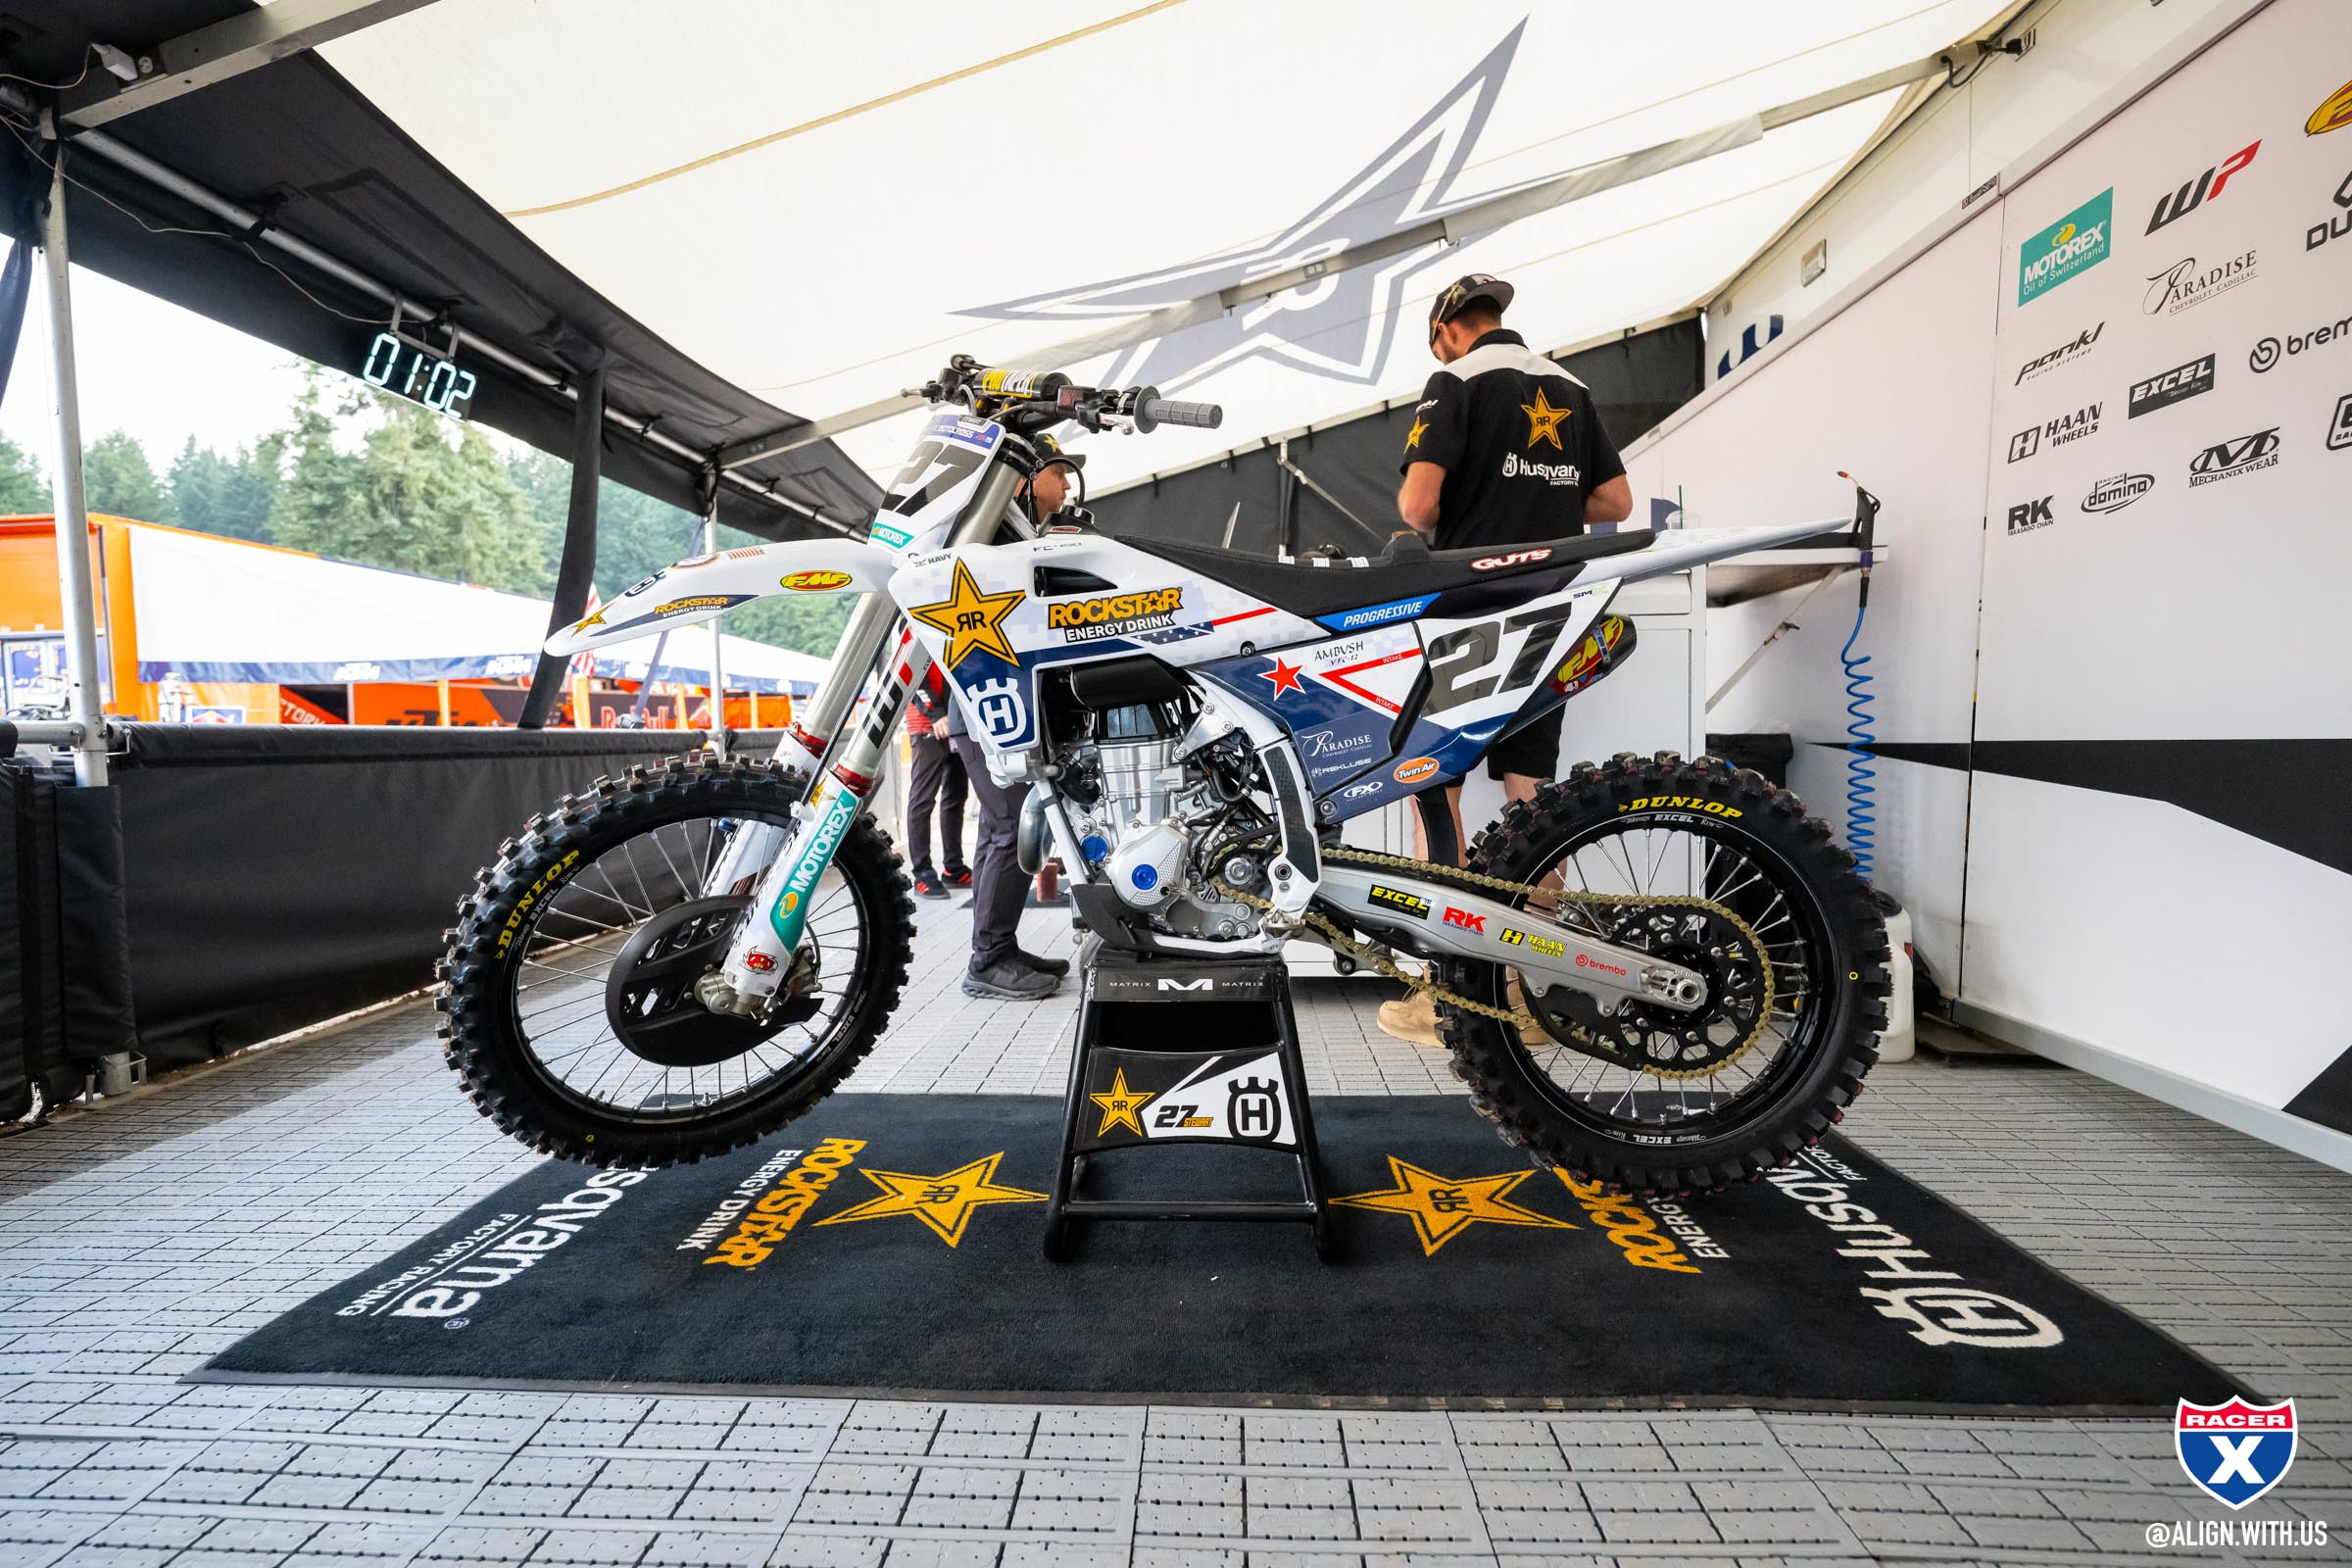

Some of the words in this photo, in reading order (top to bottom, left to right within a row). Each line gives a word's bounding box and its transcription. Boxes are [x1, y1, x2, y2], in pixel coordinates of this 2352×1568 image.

[2024, 221, 2104, 284] MOTOREX
[2024, 282, 2035, 295] Oil
[2038, 276, 2047, 287] of
[2050, 242, 2104, 281] Switzerland
[2142, 250, 2257, 315] PARADISE
[2169, 289, 2213, 313] CHEVROLET
[2217, 270, 2256, 291] CADILLAC
[2015, 321, 2105, 386] pankl
[363, 333, 477, 418] 01:02
[2132, 361, 2212, 403] EXCEL
[2045, 402, 2102, 438] HAAN
[2052, 422, 2099, 448] WHEELS
[2189, 467, 2243, 488] MECHANIX
[2245, 454, 2279, 474] WEAR
[2088, 472, 2148, 508] domino
[2008, 495, 2054, 530] RK
[2036, 519, 2054, 529] CHAIN
[928, 552, 953, 564] NAVY
[1472, 549, 1551, 570] GUTS
[783, 572, 850, 587] FMF
[655, 597, 728, 614] ROCKSTAR
[662, 607, 694, 617] ENERGY
[1049, 587, 1182, 628] ROCKSTAR
[1344, 601, 1423, 628] PROGRESSIVE
[1066, 621, 1124, 642] ENERGY
[1126, 613, 1173, 631] DRINK
[1314, 640, 1364, 662] AMBUSH
[1383, 653, 1403, 664] INTAKE
[1420, 602, 1572, 718] 27
[1375, 697, 1395, 710] INTAKE
[1301, 730, 1372, 758] PARADISE
[1321, 758, 1372, 774] REKLUSE
[1397, 766, 1422, 780] Twin
[1421, 762, 1436, 772] Air
[1629, 796, 1743, 818] DUNLOP
[1654, 813, 1693, 823] EXCEL
[790, 798, 855, 893] MOTOREX
[498, 850, 579, 949] DUNLOP
[529, 888, 559, 921] EXCEL
[1371, 886, 1429, 910] EXCEL
[1443, 906, 1488, 933] RK
[1443, 920, 1468, 932] TAKASAGO
[1528, 934, 1567, 952] HAAN
[1531, 946, 1563, 957] WHEELS
[1590, 959, 1627, 976] brembo
[1154, 1104, 1200, 1128] 27
[1183, 1117, 1214, 1128] STEWART
[1633, 1134, 1672, 1145] EXCEL
[739, 1150, 804, 1200] ENERGY
[703, 1138, 868, 1268] ROCKSTAR
[429, 1212, 520, 1262] FACTORY
[676, 1198, 750, 1251] DRINK
[335, 1265, 432, 1316] RACING
